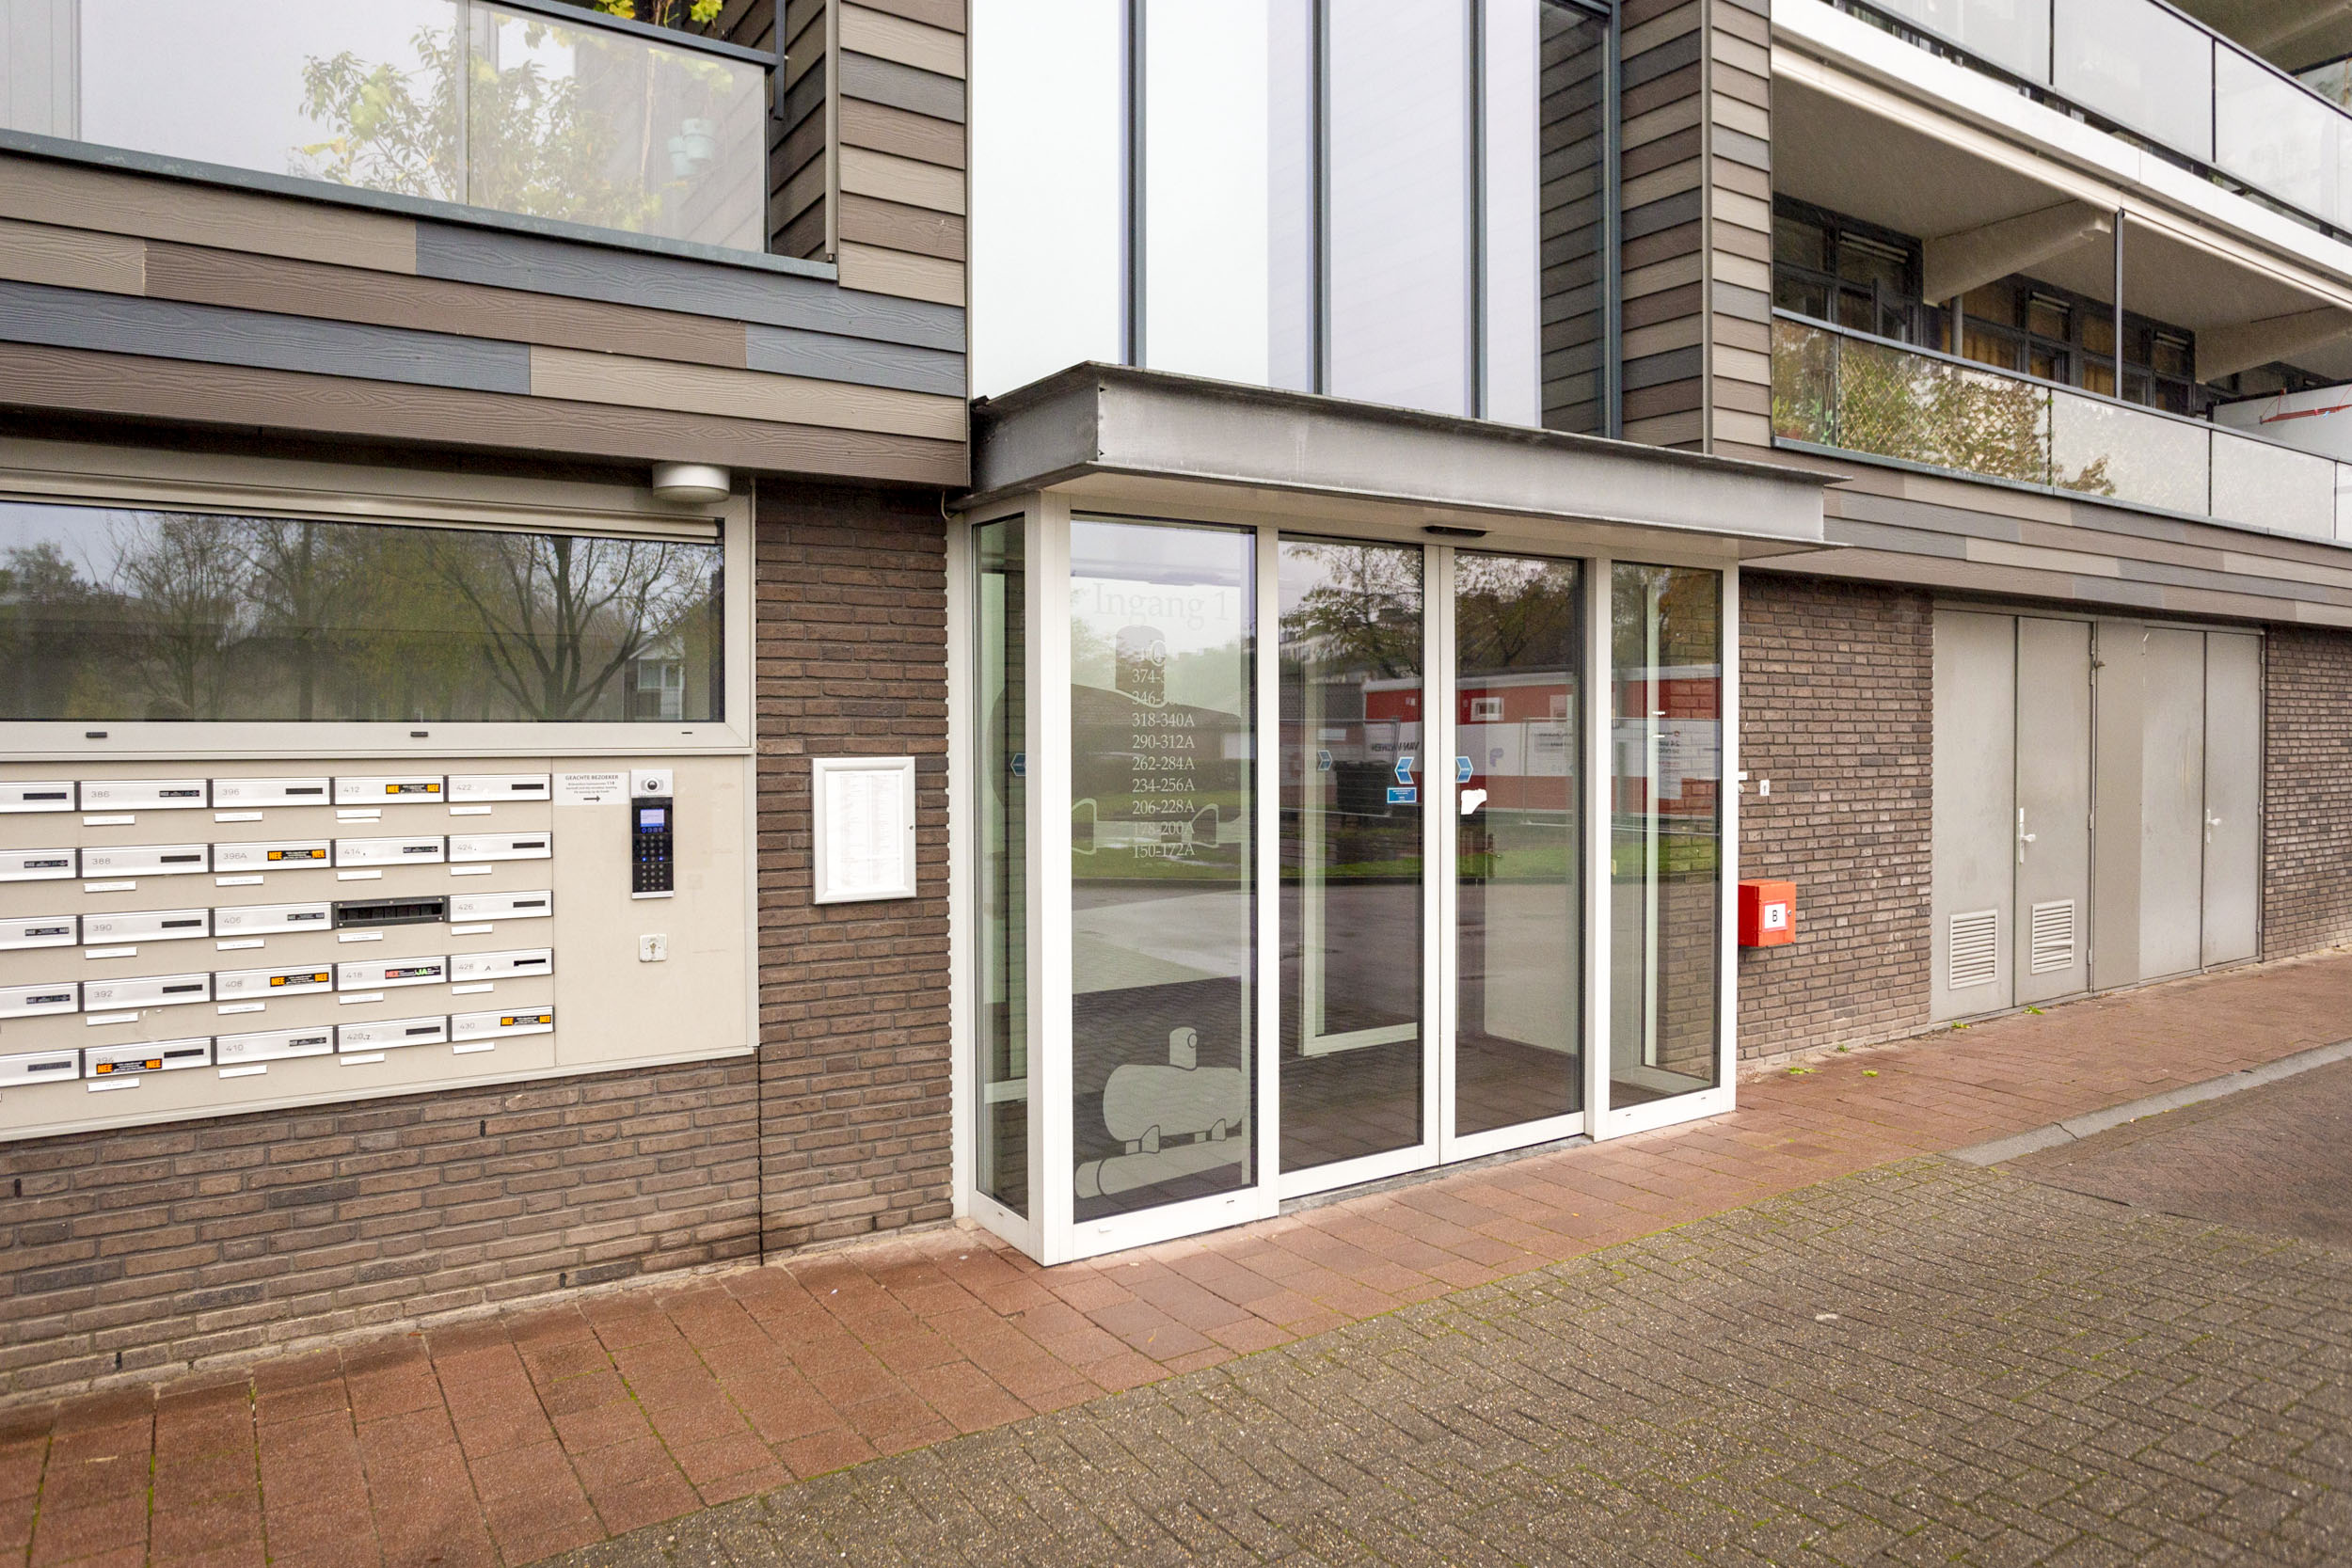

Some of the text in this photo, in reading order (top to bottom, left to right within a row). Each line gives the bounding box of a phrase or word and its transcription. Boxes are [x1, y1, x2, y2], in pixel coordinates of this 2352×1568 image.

[1093, 582, 1230, 632] Ingang 1
[1132, 712, 1195, 727] 318-340A
[1132, 735, 1195, 749] 290-312A
[1132, 756, 1195, 770] 262-284A
[343, 785, 359, 794] 412
[456, 784, 472, 792] 422
[1132, 778, 1195, 792] 234-256A
[222, 788, 240, 797] 396
[1132, 800, 1195, 815] 206-228A
[223, 851, 247, 861] 396A
[268, 851, 282, 861] NEE
[312, 849, 326, 859] NEE
[1133, 843, 1195, 859] 150-172A
[91, 858, 111, 866] 388
[224, 916, 242, 925] 406
[93, 924, 112, 932] 390
[271, 977, 286, 987] NEE
[315, 974, 328, 983] NEE
[226, 980, 243, 989] 408
[94, 990, 113, 999] 392
[459, 1022, 475, 1031] 430
[226, 1043, 244, 1053] 410
[97, 1064, 113, 1074] NEE
[146, 1059, 161, 1069] NEE
